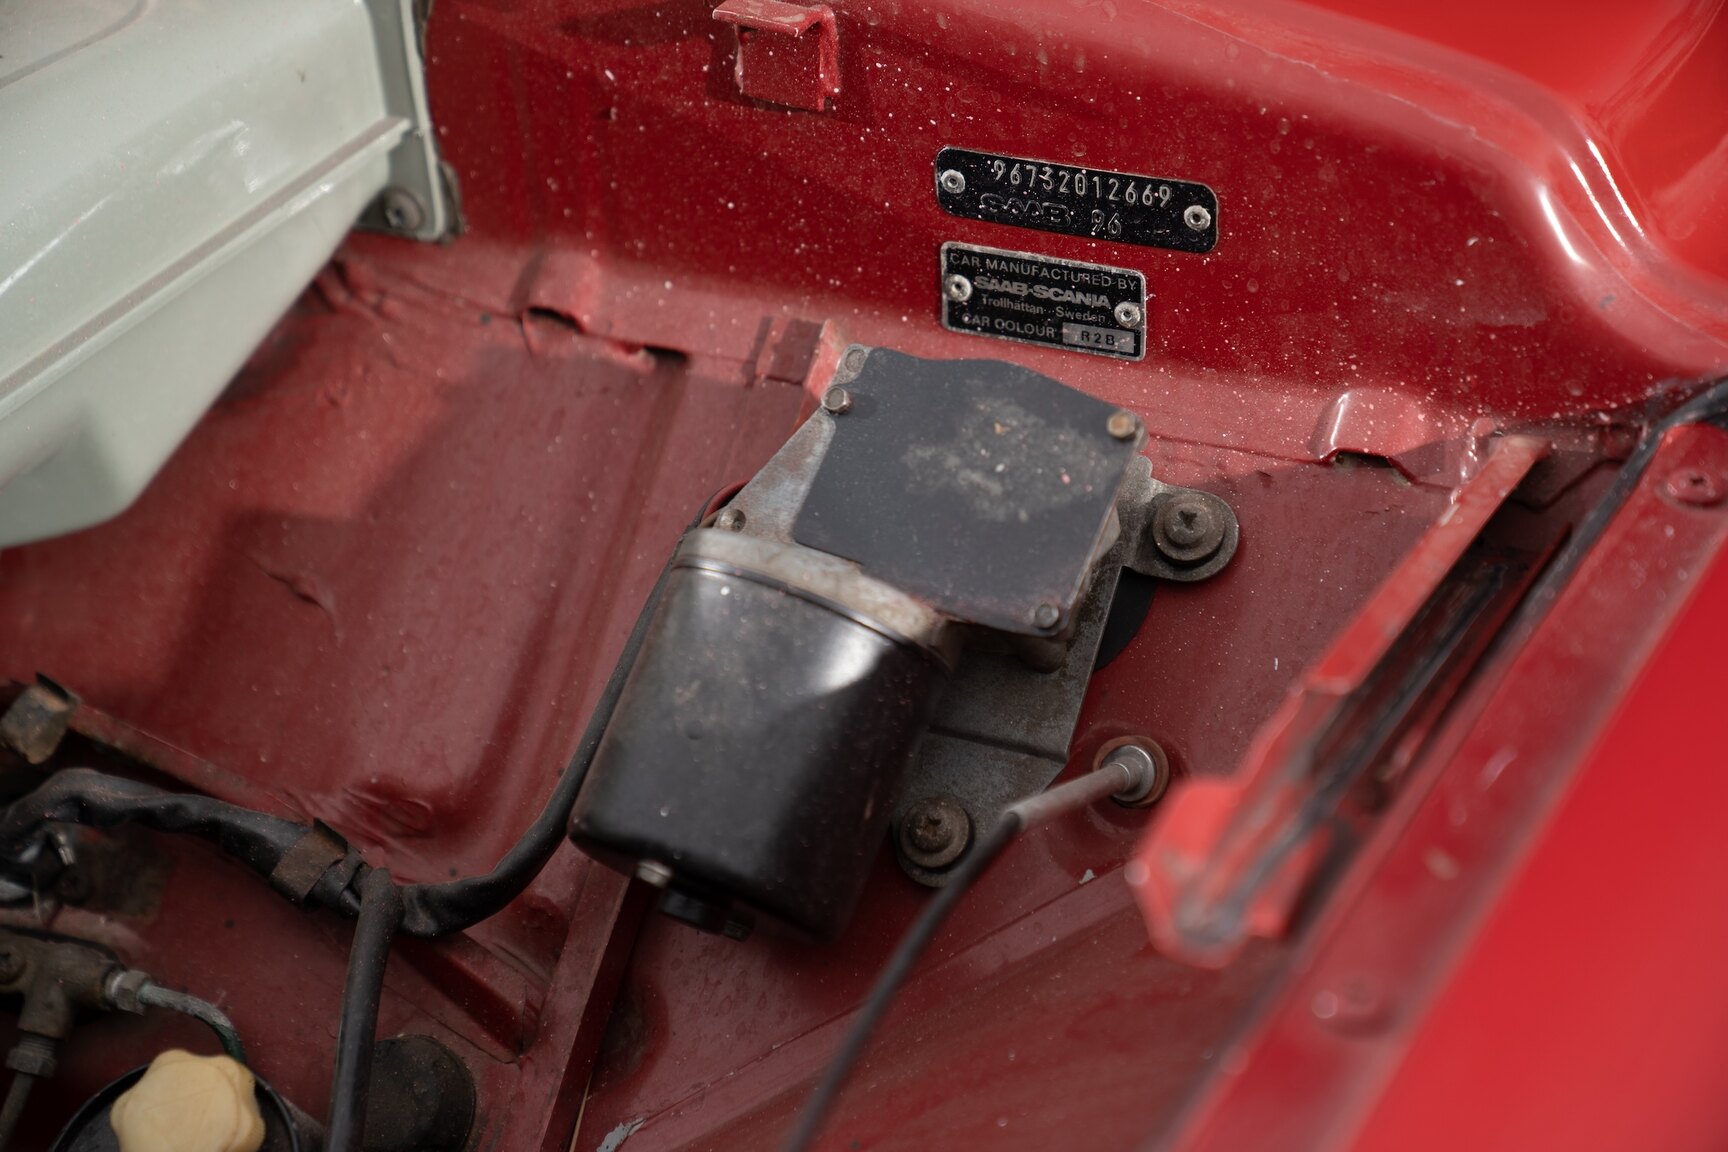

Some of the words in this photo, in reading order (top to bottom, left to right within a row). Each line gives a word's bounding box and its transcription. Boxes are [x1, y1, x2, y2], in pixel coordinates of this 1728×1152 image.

[993, 159, 1172, 208] 96732012669
[980, 193, 1071, 227] SAAB
[1091, 209, 1122, 236] 96
[950, 253, 980, 267] CAR
[986, 258, 1112, 287] MANUFACTURED
[1117, 279, 1137, 290] BY
[974, 275, 1112, 309] SAAB-SCANIA
[962, 313, 990, 326] CAR
[994, 318, 1056, 338] COLOUR
[1055, 306, 1106, 323] Sweden
